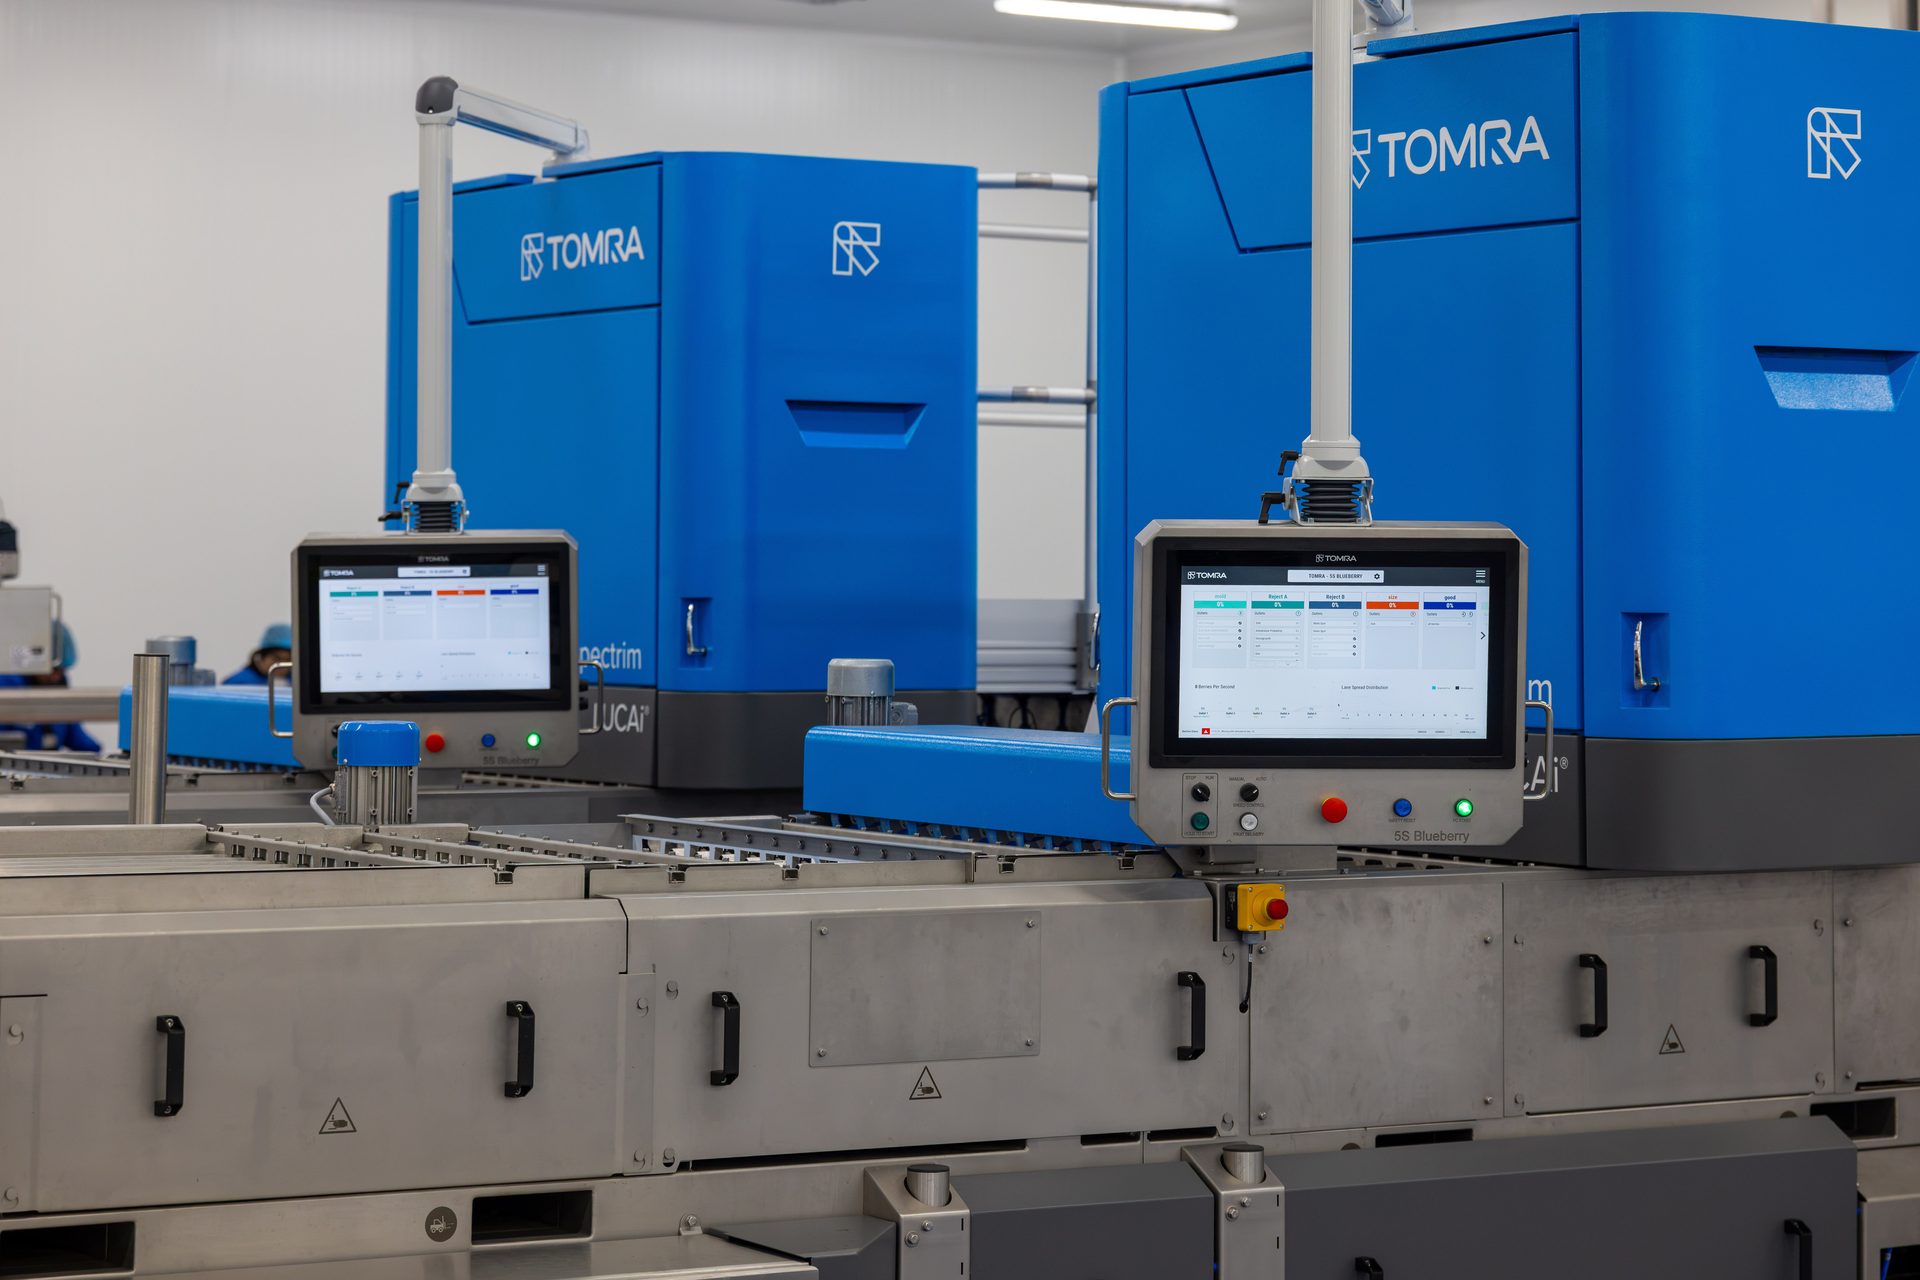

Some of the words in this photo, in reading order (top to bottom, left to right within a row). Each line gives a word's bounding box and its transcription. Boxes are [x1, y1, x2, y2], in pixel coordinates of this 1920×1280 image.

[1377, 115, 1550, 178] TOMRA
[546, 225, 645, 271] TOMRA
[1324, 554, 1357, 562] TOMRA
[579, 641, 642, 675] pectrim
[497, 756, 540, 766] Blueberry
[1394, 830, 1410, 842] 5S
[1413, 830, 1470, 843] Blueberry
